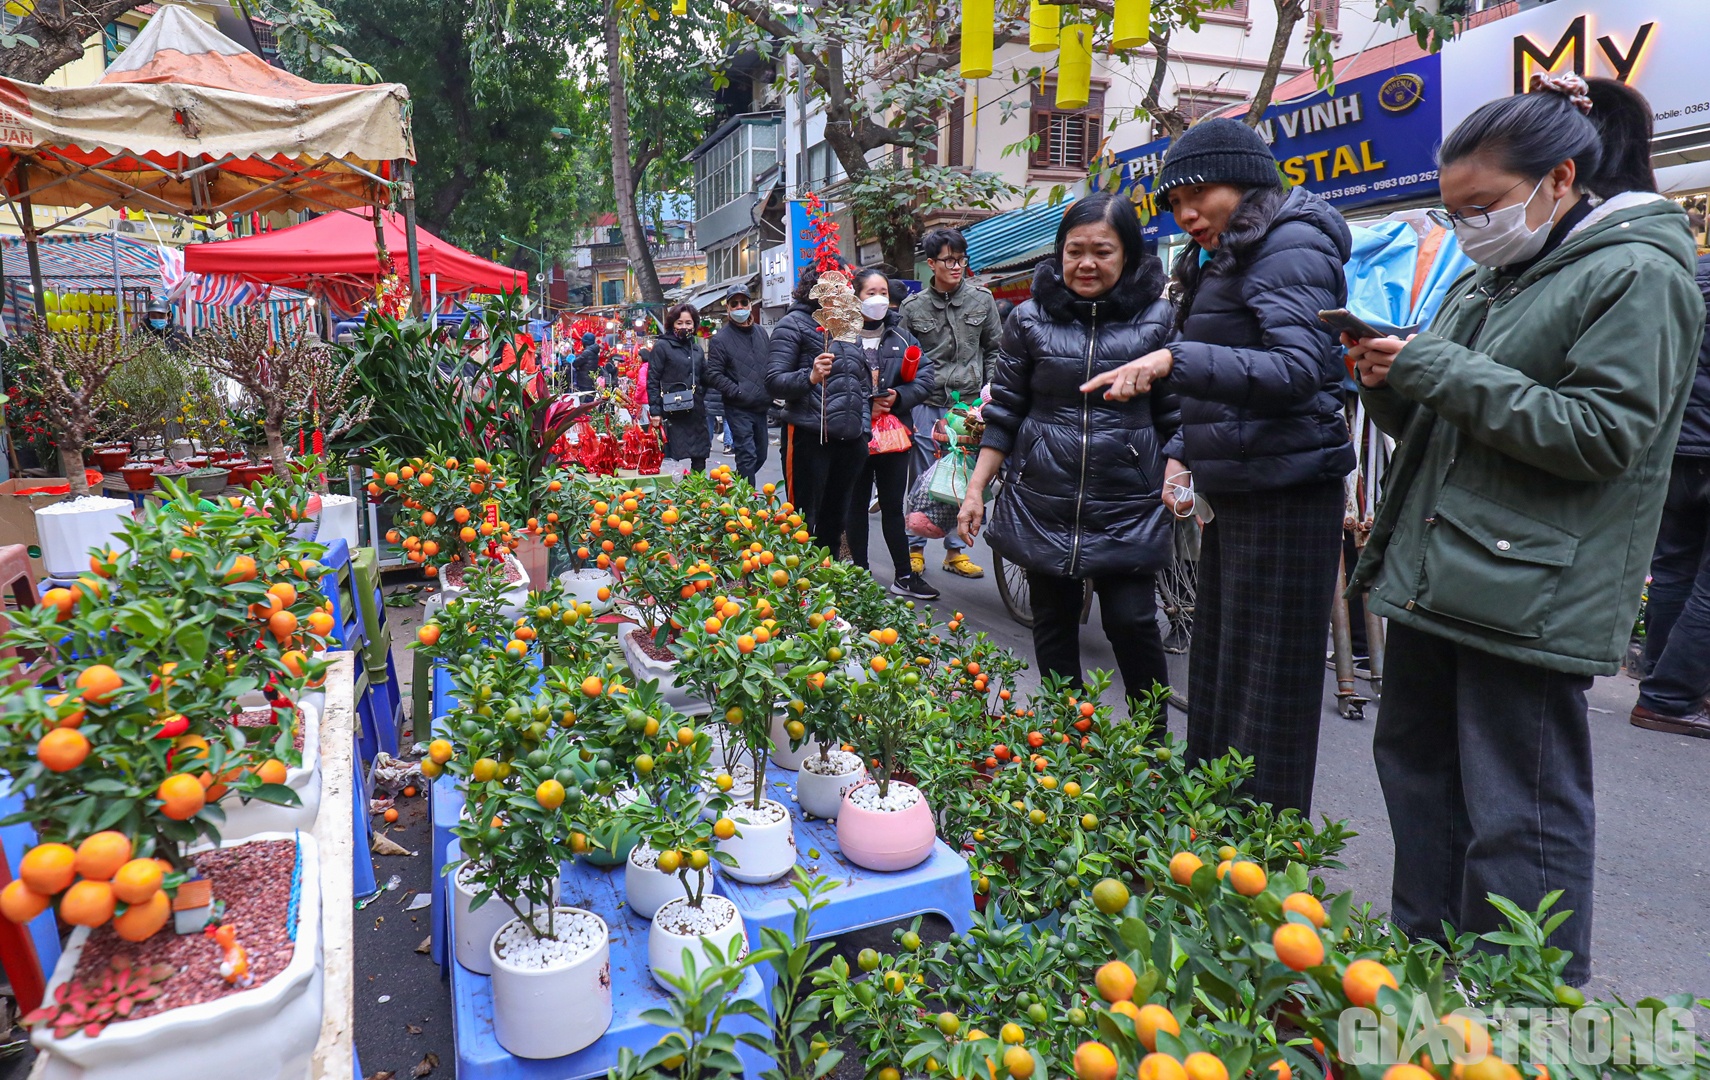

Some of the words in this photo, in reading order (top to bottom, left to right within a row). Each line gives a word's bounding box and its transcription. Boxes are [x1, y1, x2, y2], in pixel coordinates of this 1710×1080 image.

[1279, 92, 1362, 139] VINH
[1684, 101, 1710, 115] 0363
[1276, 139, 1386, 188] STAL
[1344, 183, 1367, 196] 6996
[1373, 178, 1398, 191] 0983
[1398, 173, 1418, 186] 020
[1418, 169, 1439, 182] 262
